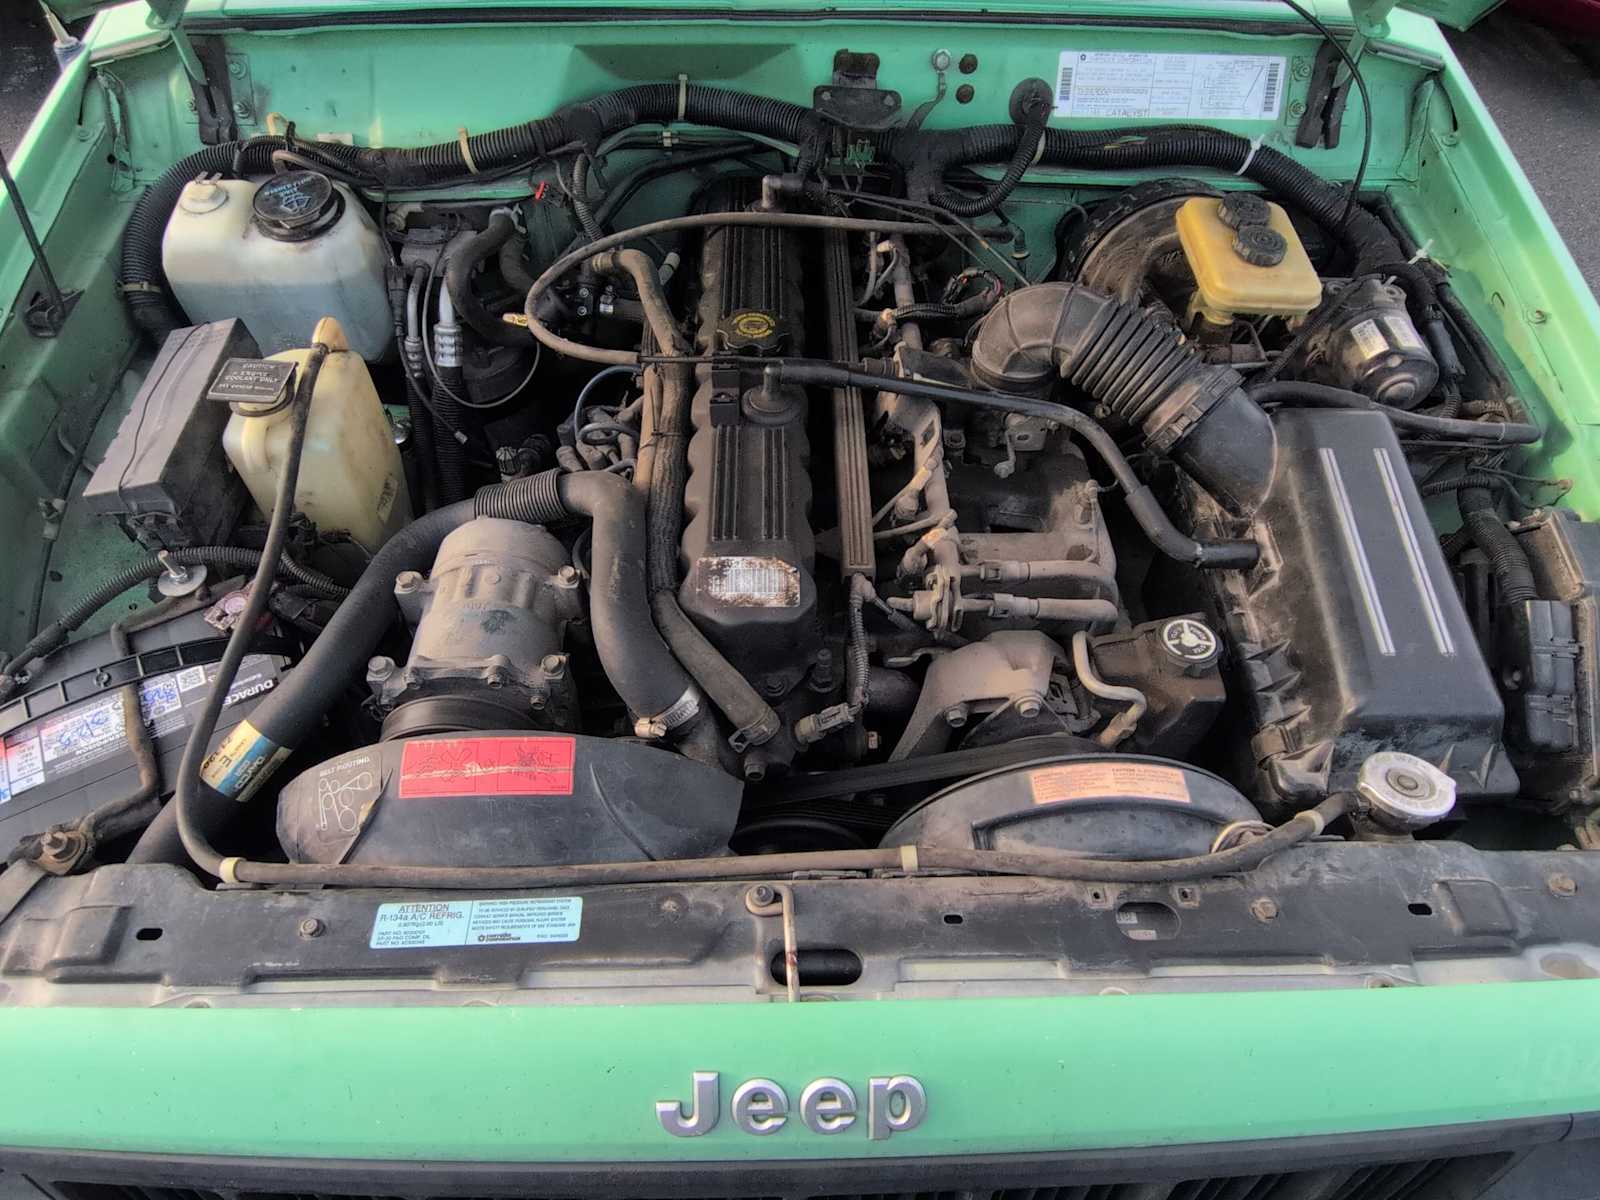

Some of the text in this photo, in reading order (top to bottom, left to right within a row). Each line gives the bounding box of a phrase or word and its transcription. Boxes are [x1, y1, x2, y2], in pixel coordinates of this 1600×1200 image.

[398, 903, 449, 914] ATTENTION
[410, 912, 427, 921] A/C
[429, 911, 465, 920] REFRIG.
[655, 1071, 927, 1140] Jeep
